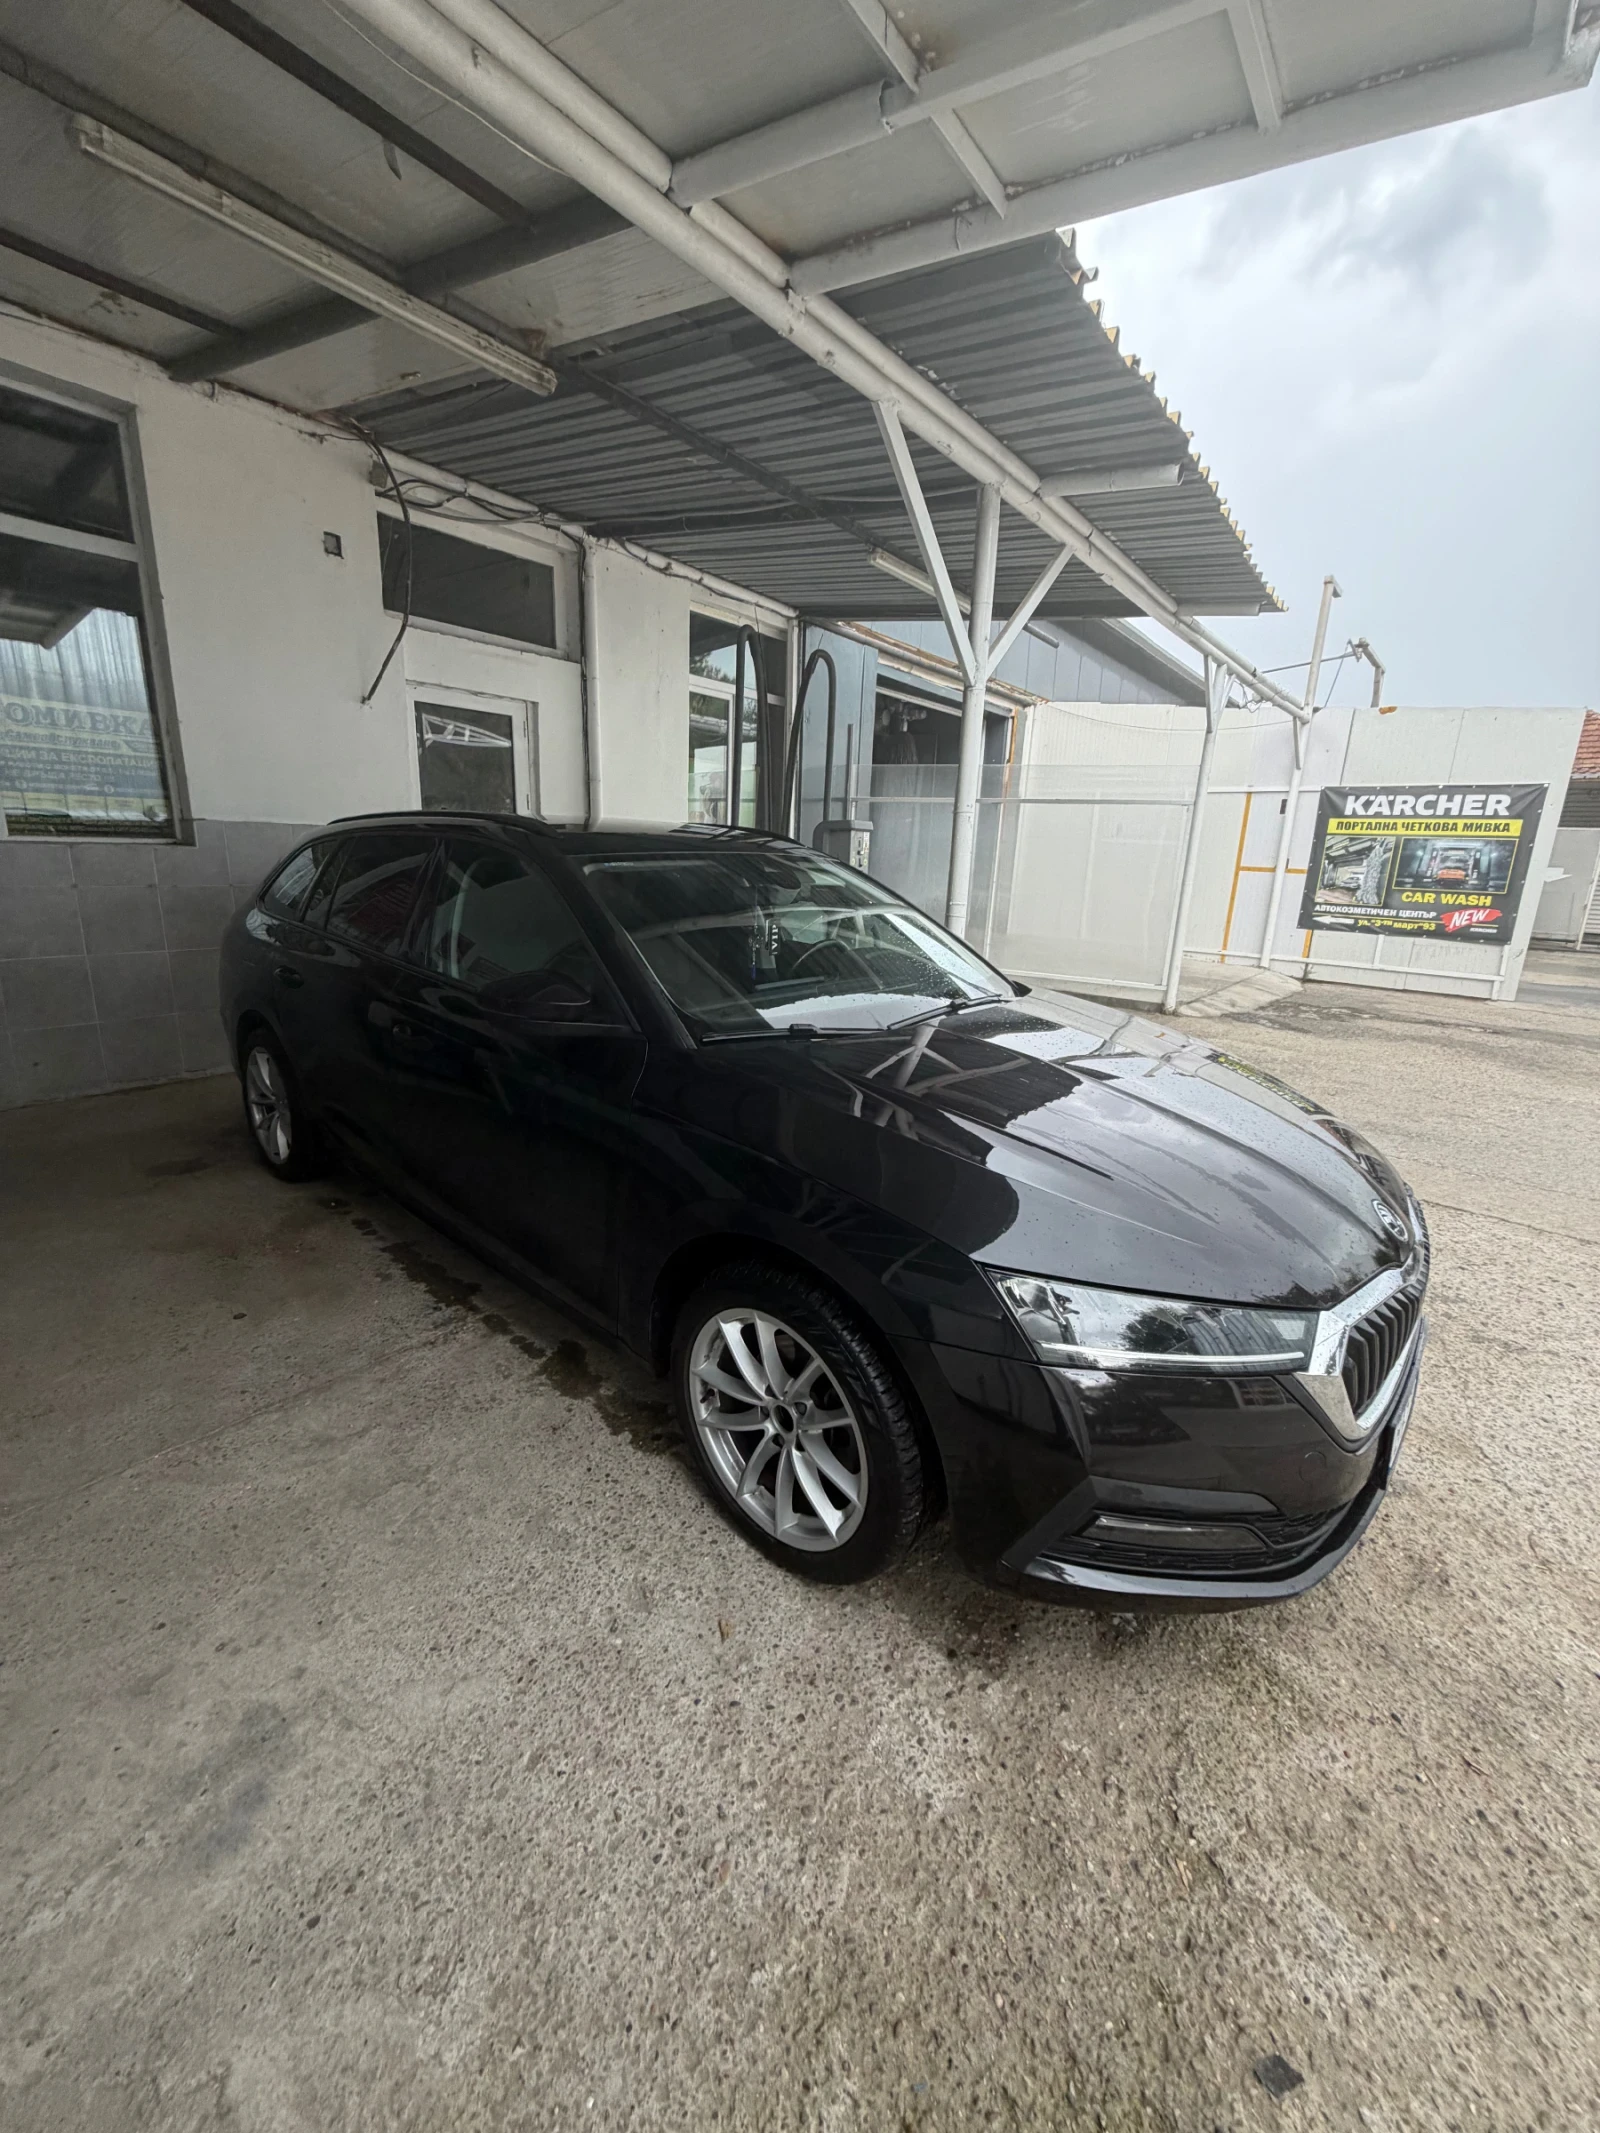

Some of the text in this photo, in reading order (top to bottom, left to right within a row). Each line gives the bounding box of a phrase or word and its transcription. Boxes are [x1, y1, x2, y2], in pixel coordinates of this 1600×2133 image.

[1344, 794, 1511, 816] KÄRCHER
[1336, 821, 1510, 833] ПОРТАЛНА ЧЕТКОВА МИВКА
[1401, 891, 1493, 907] CAR WASH
[1314, 904, 1397, 916] АВТОКОЗМЕТИЧЕН
[1450, 909, 1489, 929] NEW
